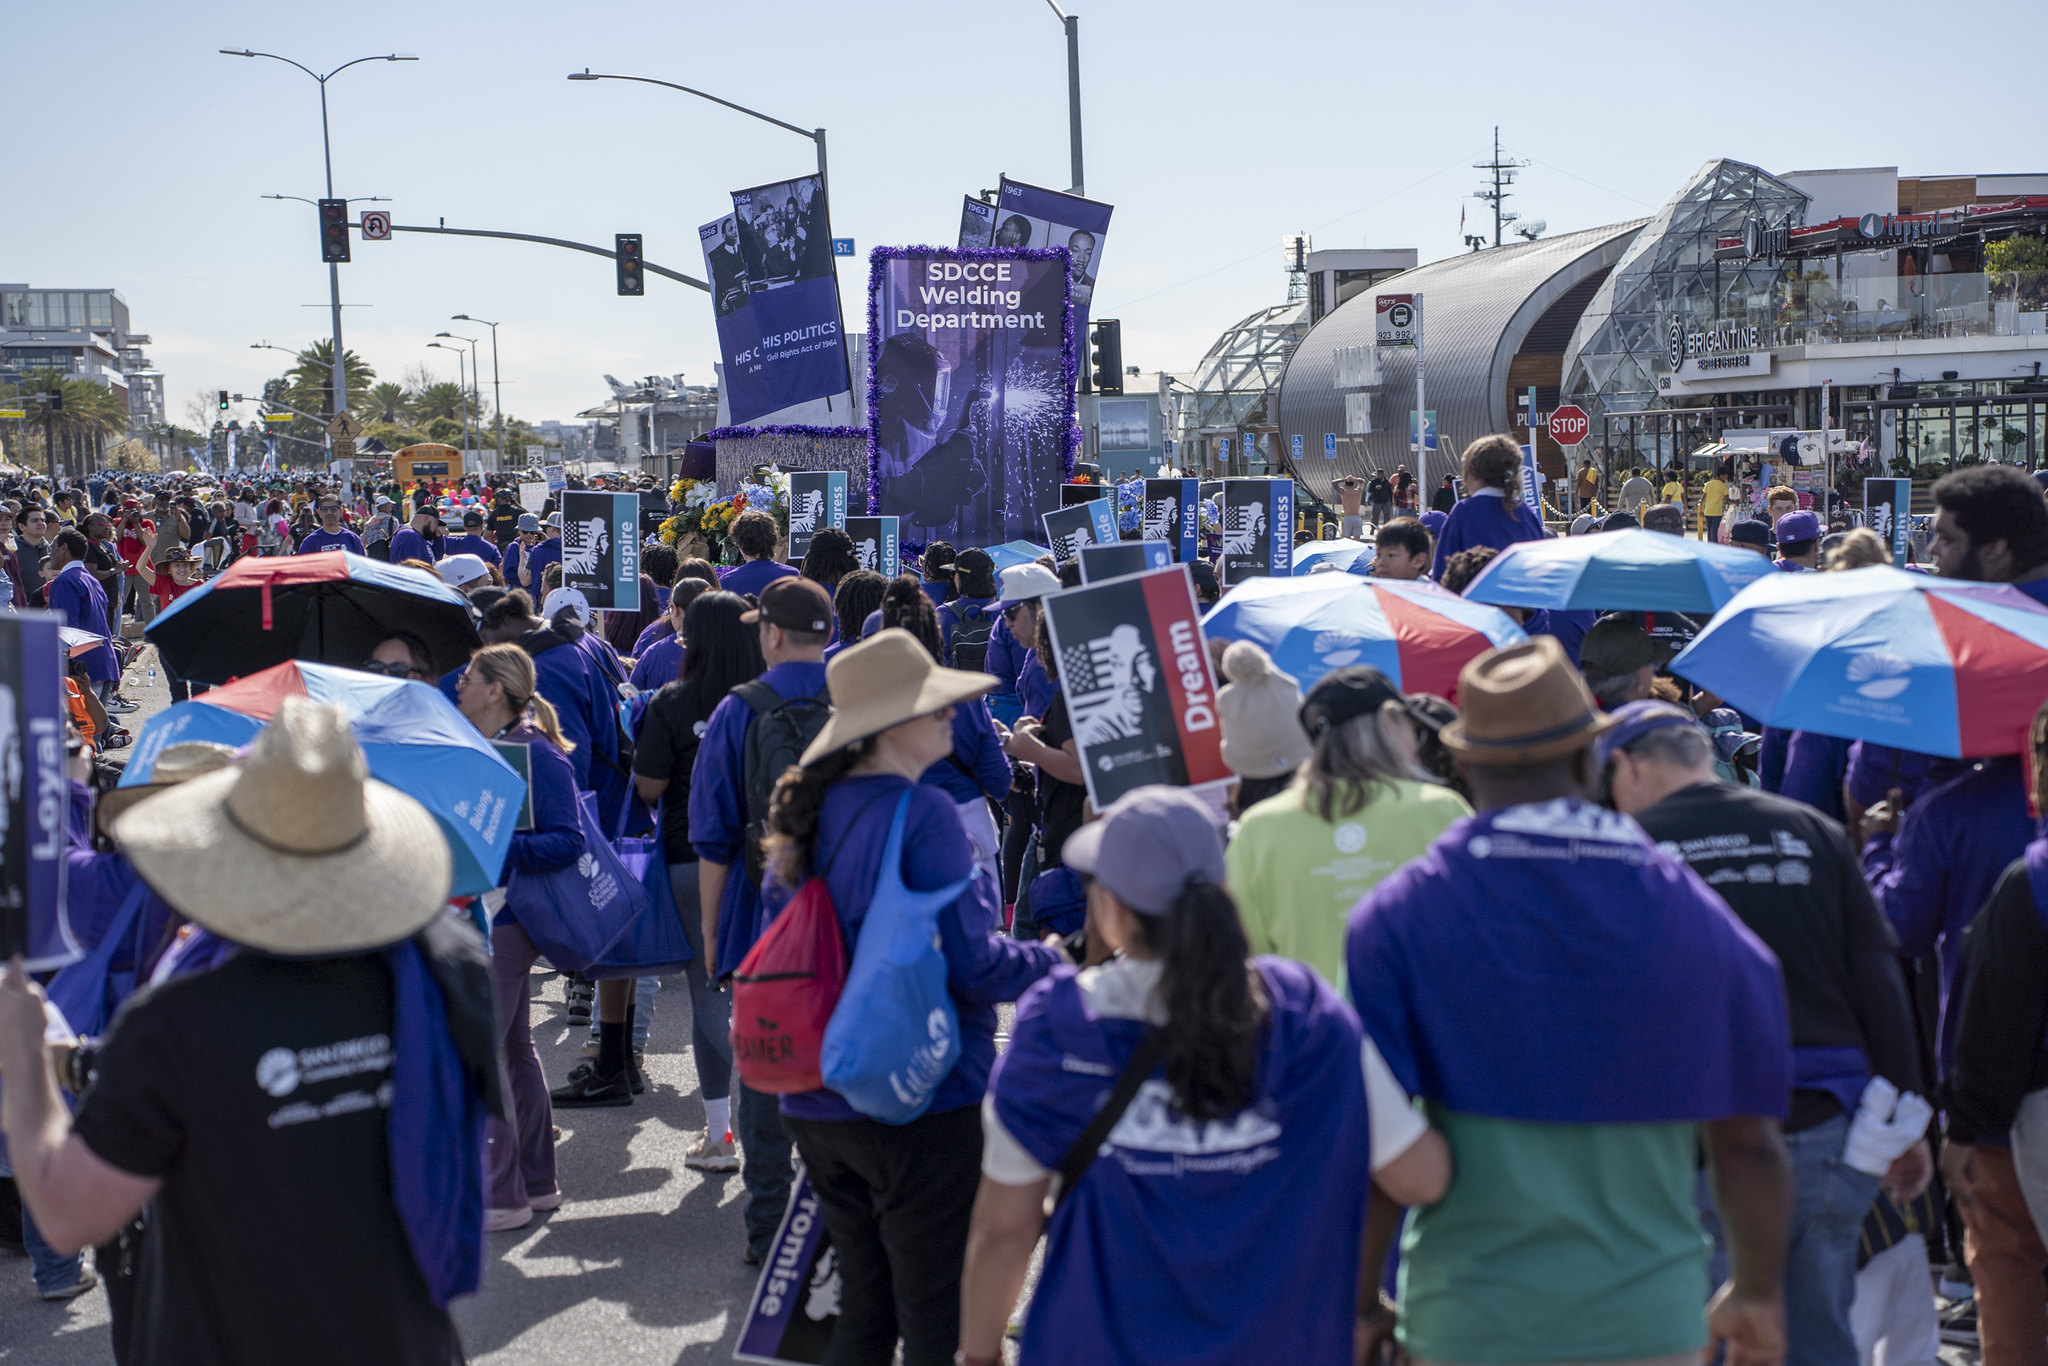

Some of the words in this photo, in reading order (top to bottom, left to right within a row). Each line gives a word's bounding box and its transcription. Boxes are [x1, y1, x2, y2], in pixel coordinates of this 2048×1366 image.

[734, 194, 751, 205] 1964
[1004, 185, 1023, 197] 1963
[967, 203, 986, 215] 1963
[700, 226, 716, 239] 1956
[928, 262, 1012, 282] SDCCE
[919, 284, 1021, 310] Welding
[897, 309, 1046, 333] Department
[762, 334, 781, 350] HIS
[784, 321, 836, 345] POLITICS
[1378, 331, 1392, 340] 923
[1395, 330, 1411, 339] 992
[1687, 327, 1758, 354] BRIGANTINE
[735, 349, 752, 366] HIS
[753, 346, 760, 358] C
[780, 348, 800, 360] Rights
[801, 345, 813, 354] Act
[822, 338, 838, 349] 1964
[1552, 418, 1586, 434] STOP
[528, 456, 543, 465] 25
[833, 486, 845, 529] ogress
[1183, 503, 1196, 539] Pride
[1273, 495, 1289, 569] Kindness
[1895, 511, 1908, 555] Light
[618, 521, 637, 582] Inspire
[1169, 619, 1216, 733] Dream
[29, 717, 66, 861] Loyal
[733, 1033, 795, 1064] EAMER
[759, 1197, 819, 1318] romise
